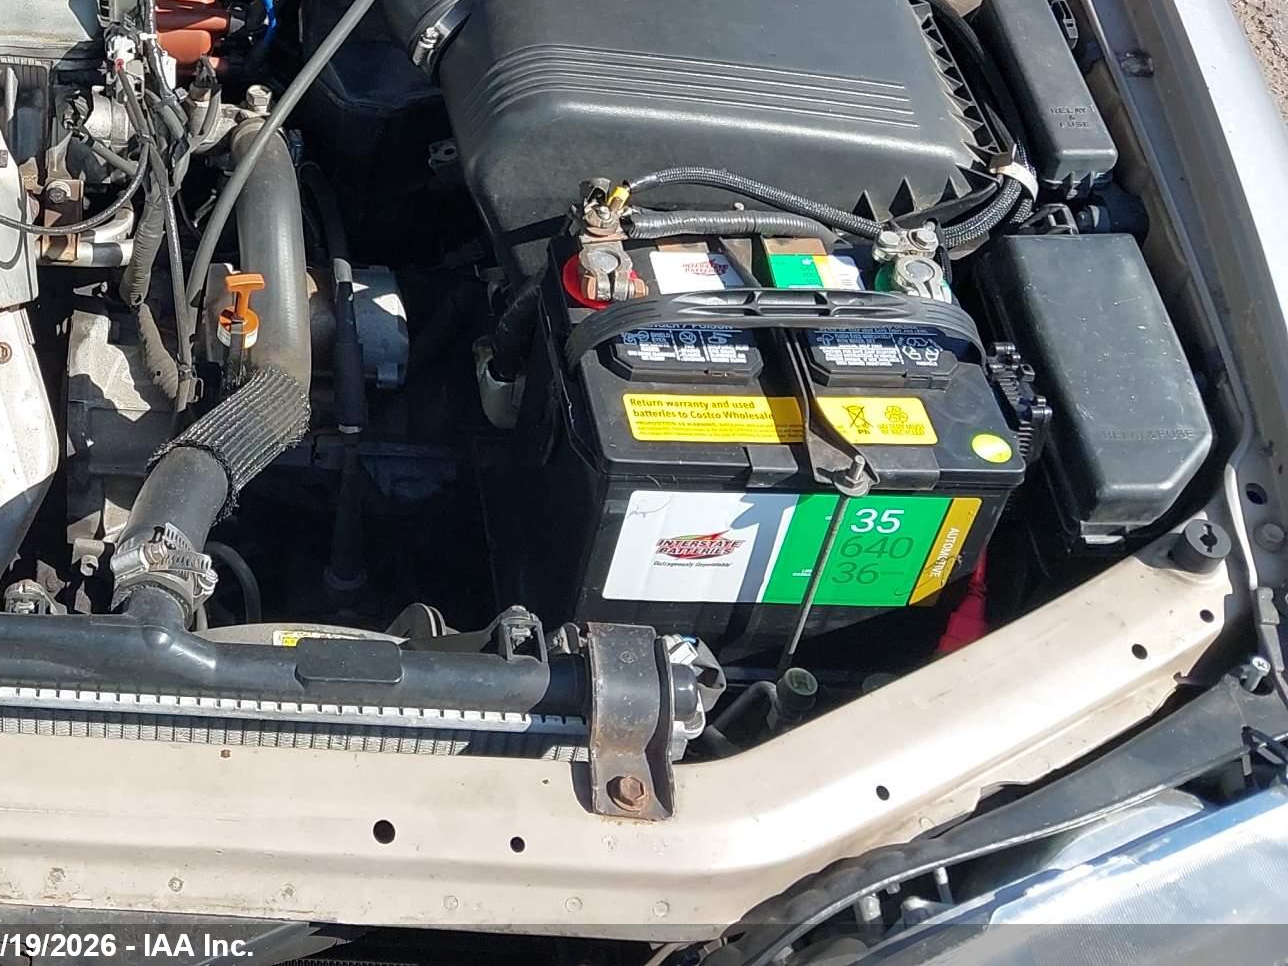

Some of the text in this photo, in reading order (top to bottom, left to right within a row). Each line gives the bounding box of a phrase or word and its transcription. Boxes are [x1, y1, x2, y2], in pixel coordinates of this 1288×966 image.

[630, 398, 756, 410] Return warranty and used
[632, 410, 774, 420] batteries to Costco Wholesale
[850, 508, 904, 533] 35
[656, 539, 744, 547] INTERSTATE
[839, 536, 914, 560] 640
[656, 547, 733, 555] BATTERIES
[831, 561, 879, 585] 36
